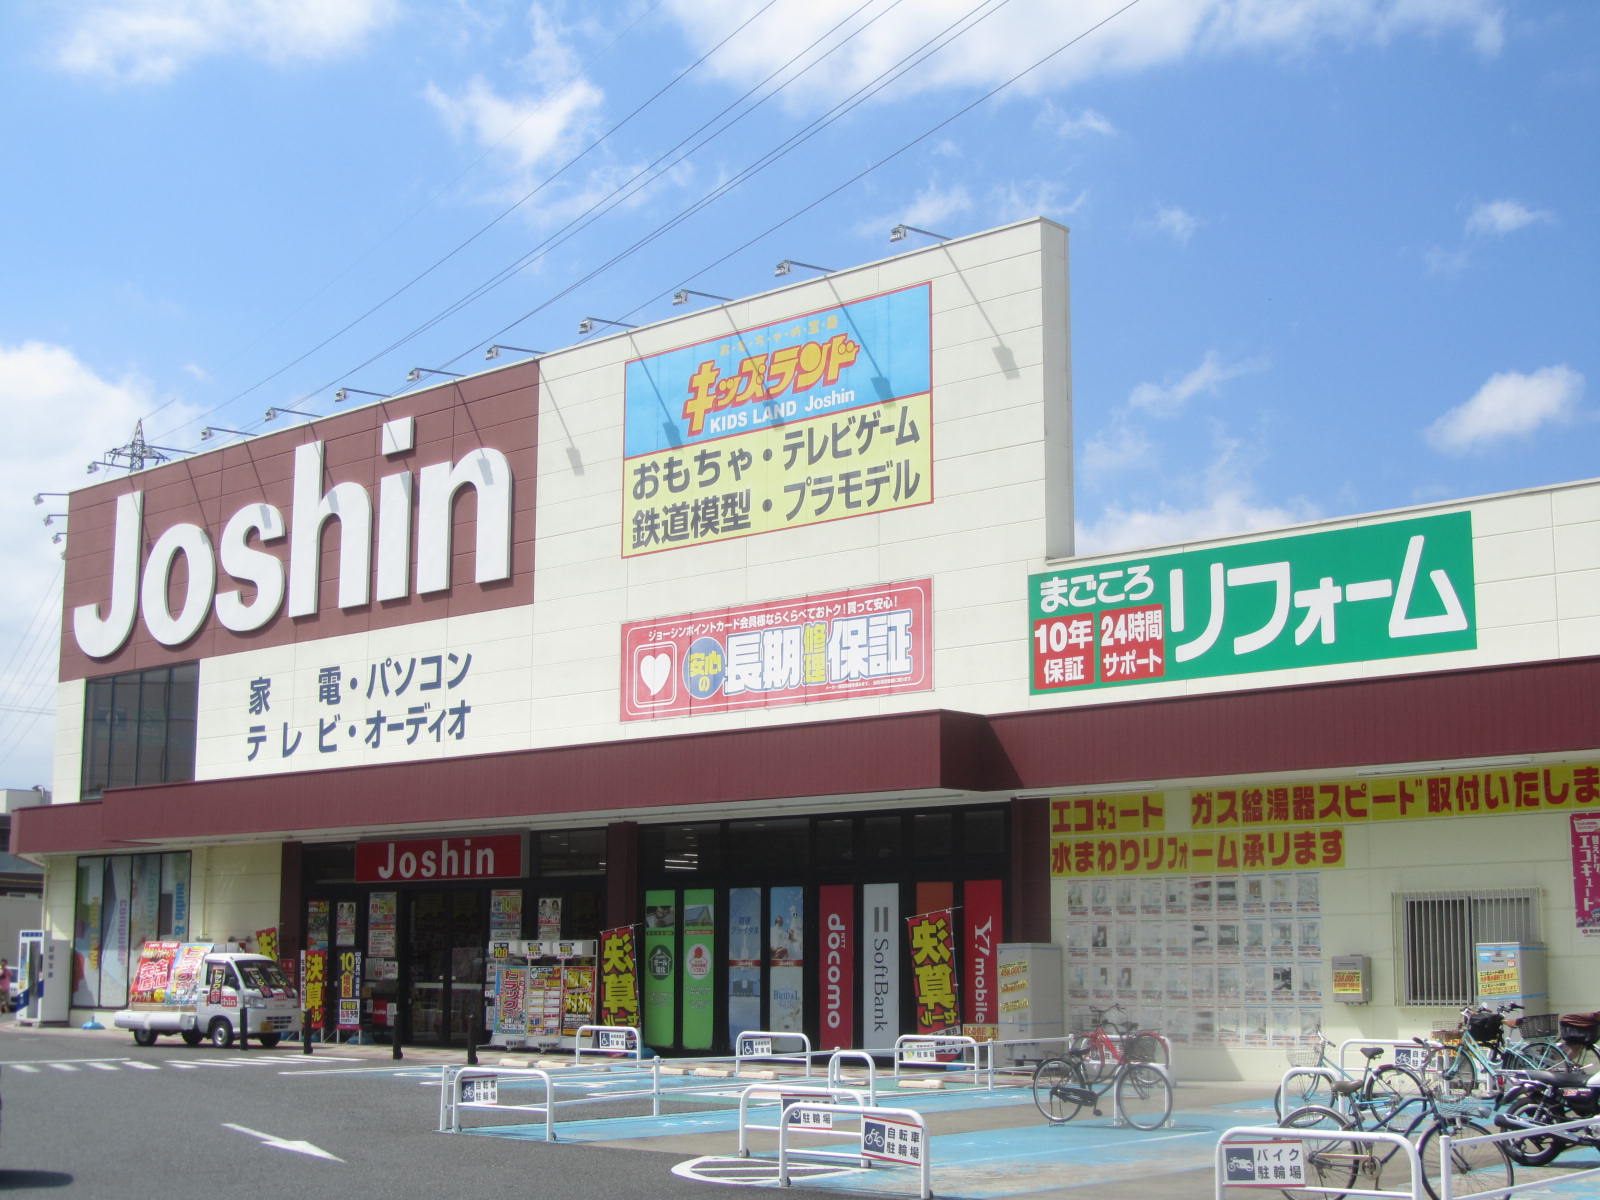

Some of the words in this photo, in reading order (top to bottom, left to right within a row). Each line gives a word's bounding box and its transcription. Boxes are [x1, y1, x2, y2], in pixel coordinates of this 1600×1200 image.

[682, 333, 861, 437] キッズランド
[710, 411, 748, 434] KIDS
[753, 401, 797, 424] LAND
[804, 388, 855, 412] Joshin
[632, 405, 921, 500] おもちゃ・テレビゲーム
[632, 459, 921, 549] 鉄道模型・プラモデル
[73, 416, 513, 658] Joshin
[1040, 565, 1154, 613] まごころ
[1169, 535, 1468, 663] リフォーム
[827, 610, 912, 682] 保証
[1034, 618, 1093, 653] 10年
[1101, 609, 1163, 646] 24時間
[689, 650, 722, 678] 安心
[724, 628, 801, 695] 長期
[804, 622, 826, 684] 修理
[1044, 657, 1084, 684] 保証
[1103, 648, 1162, 677] サポート
[699, 676, 710, 692] の
[247, 700, 472, 761] テレビ・オーディオ
[1052, 796, 1163, 833] エコキュート
[378, 839, 495, 879] Joshin
[1052, 829, 1344, 875] 水まわりリフォーム承ります
[827, 913, 846, 1028] docomo
[873, 937, 889, 1032] SoftBank
[886, 1141, 920, 1160] 駐輪場
[887, 1126, 920, 1144] 自転車
[1257, 1147, 1300, 1162] バイク
[1257, 1164, 1302, 1181] 駐輪場
